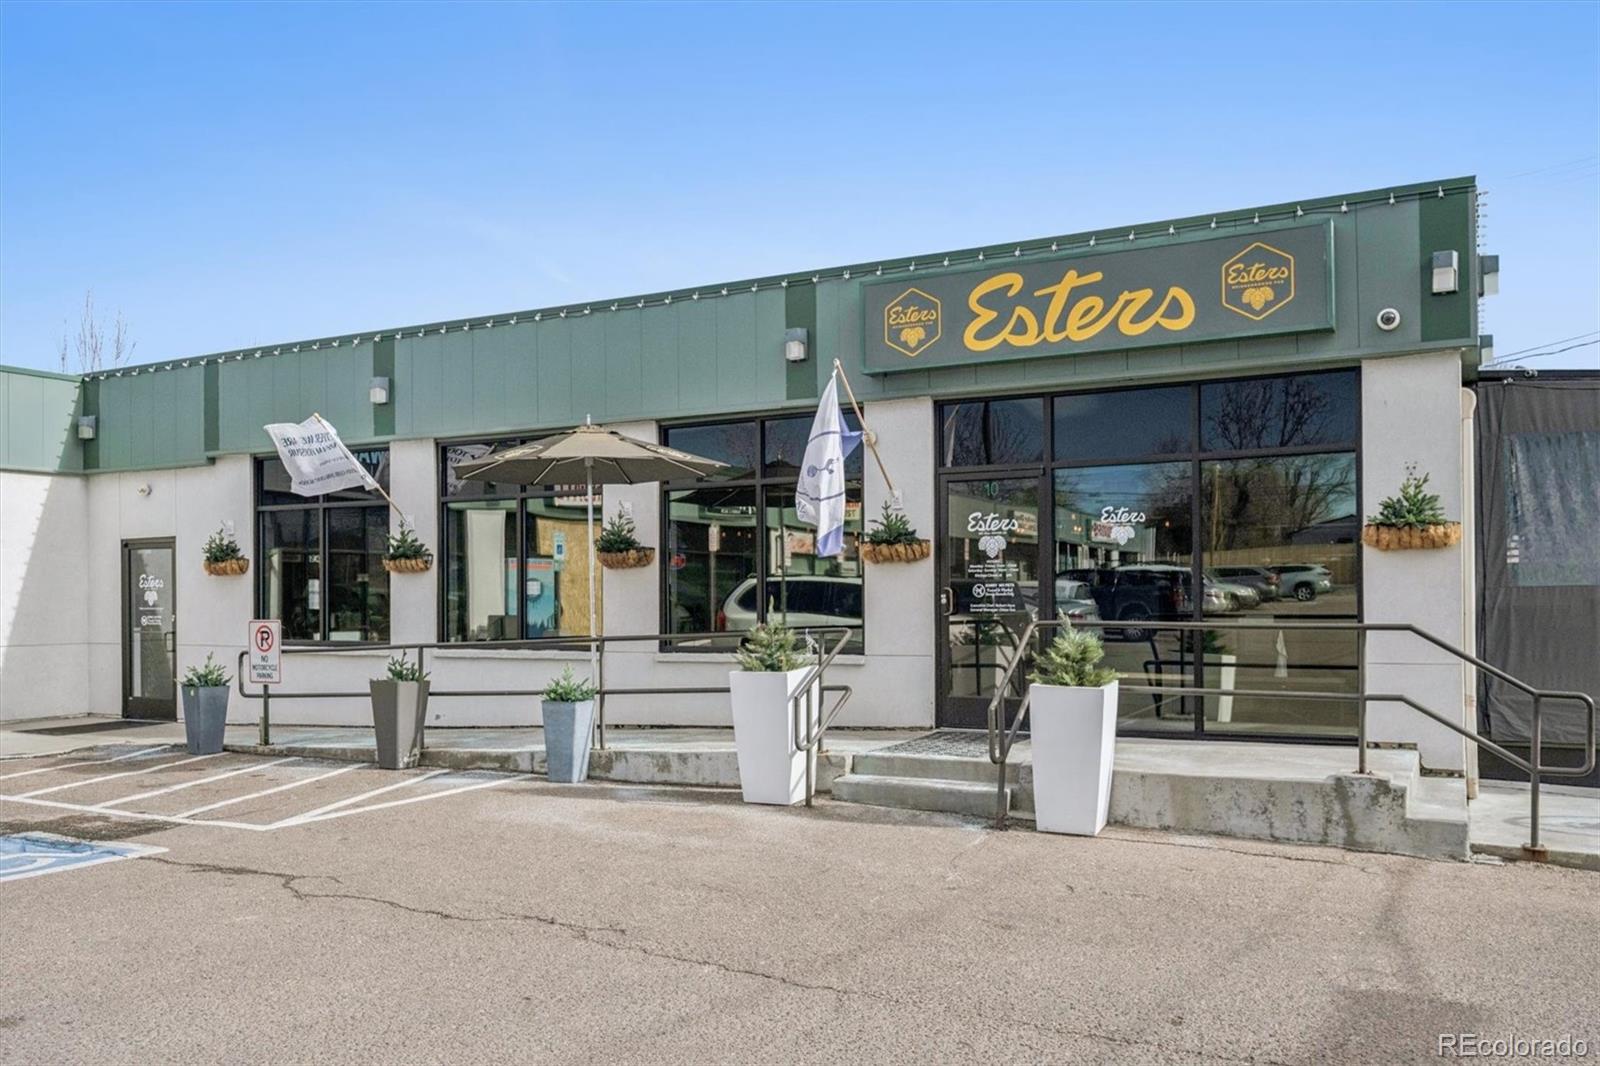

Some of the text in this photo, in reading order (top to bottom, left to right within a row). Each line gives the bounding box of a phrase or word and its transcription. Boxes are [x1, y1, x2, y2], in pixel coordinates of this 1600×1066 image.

[1228, 263, 1289, 284] Esters
[889, 305, 937, 325] Esters
[962, 269, 1196, 352] Esters
[967, 511, 1018, 532] Esters
[1100, 506, 1146, 523] Esters
[262, 655, 269, 663] NO
